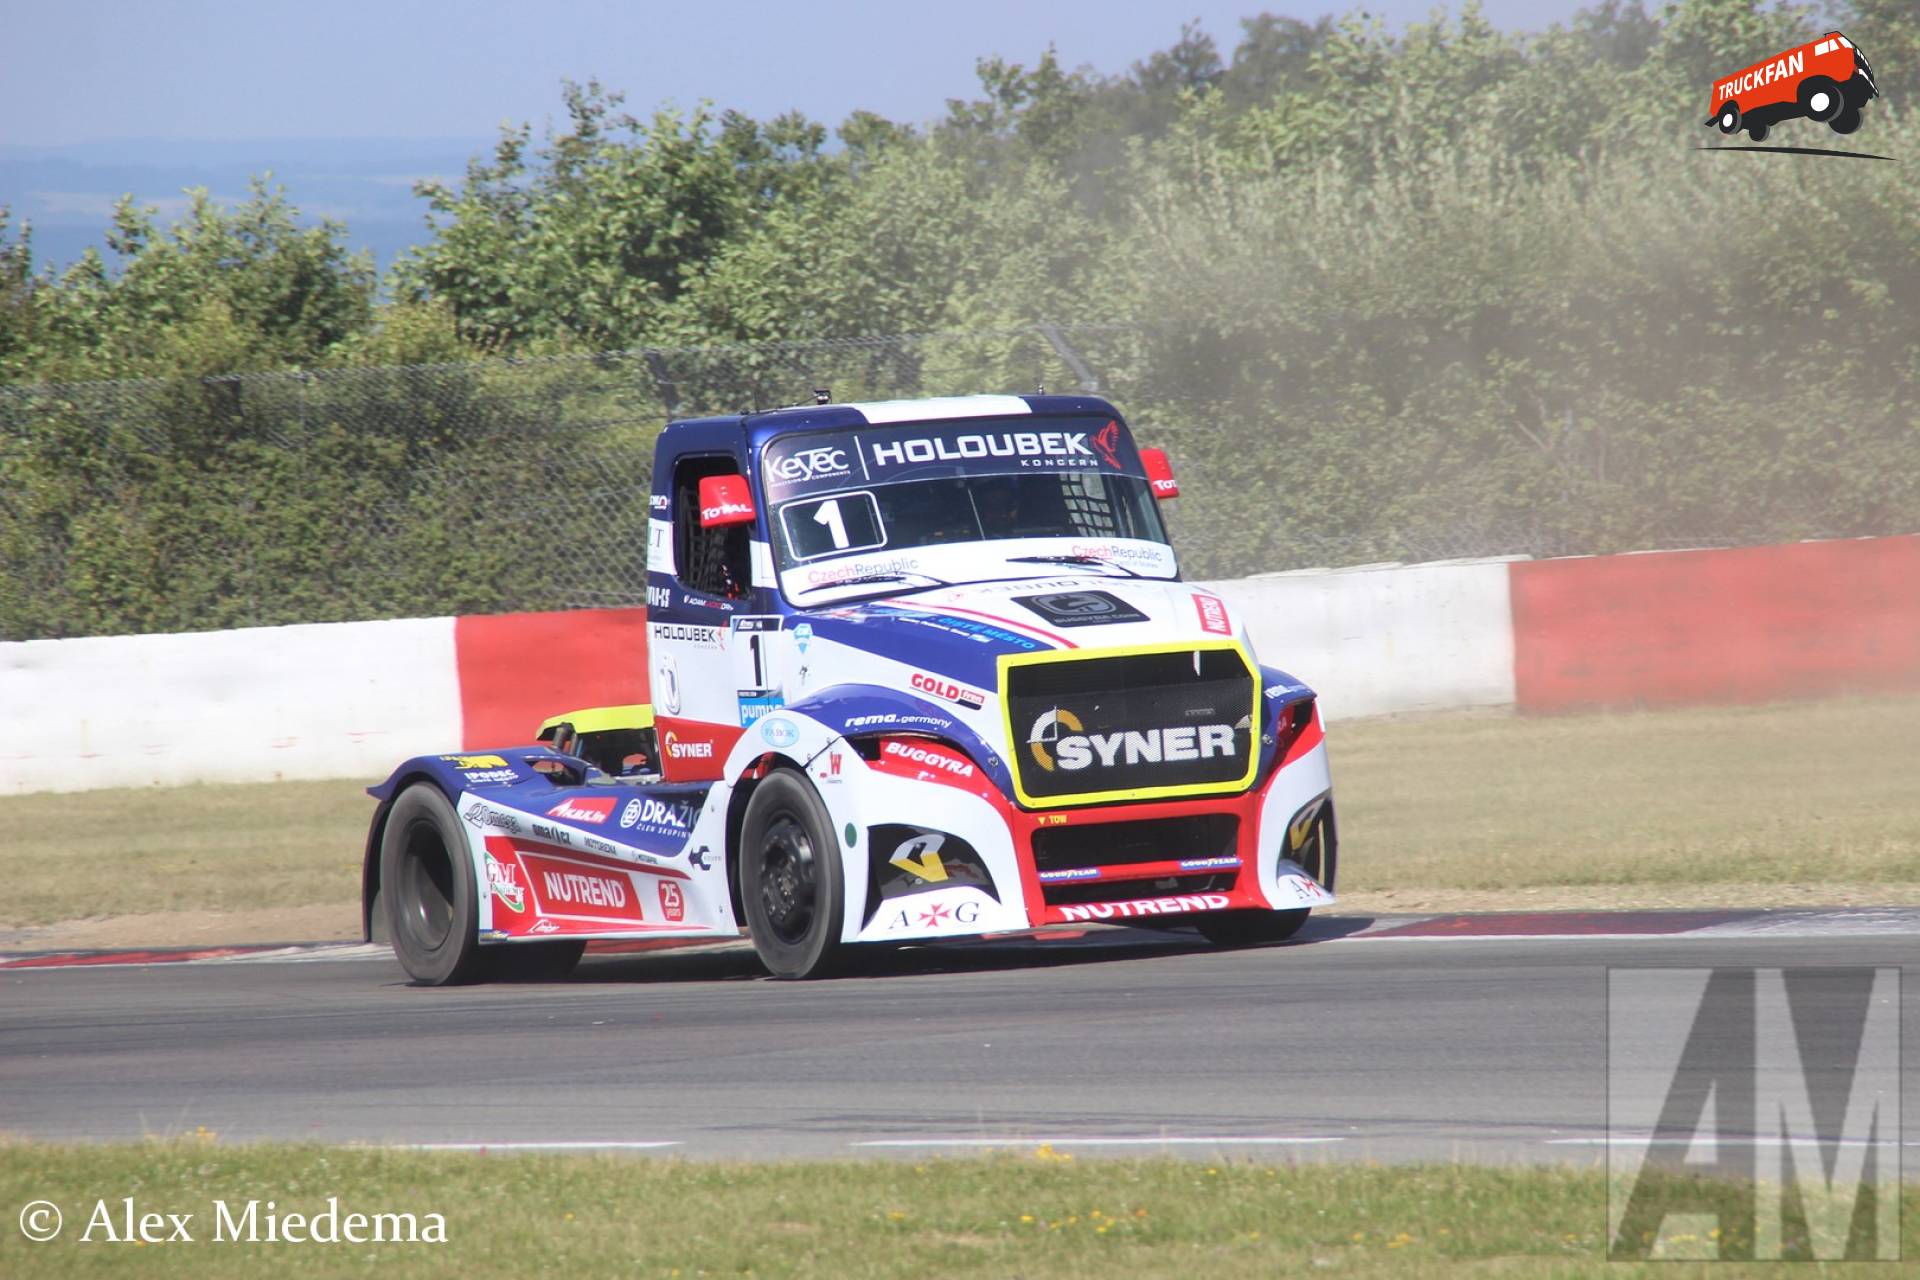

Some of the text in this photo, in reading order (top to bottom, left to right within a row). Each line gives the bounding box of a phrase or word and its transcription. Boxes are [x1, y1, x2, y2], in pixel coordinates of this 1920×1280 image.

[872, 432, 1093, 466] HOLOUBEK
[1021, 458, 1099, 467] KONCERN
[702, 504, 752, 520] TOTAL
[813, 499, 849, 549] 1
[655, 625, 716, 642] HOLOUBEK
[750, 635, 762, 687] 1
[911, 673, 960, 700] GOLD
[672, 743, 712, 758] SYNER
[885, 742, 974, 777] BUGGYRA
[1056, 723, 1236, 771] SYNER
[1049, 815, 1068, 825] TOW
[1040, 868, 1097, 878] GOODYEAR
[1181, 857, 1237, 867] GOODYEAR
[543, 871, 626, 908] NUTREND
[661, 883, 680, 907] 25
[889, 901, 980, 929] A G
[1058, 895, 1231, 921] NUTREND
